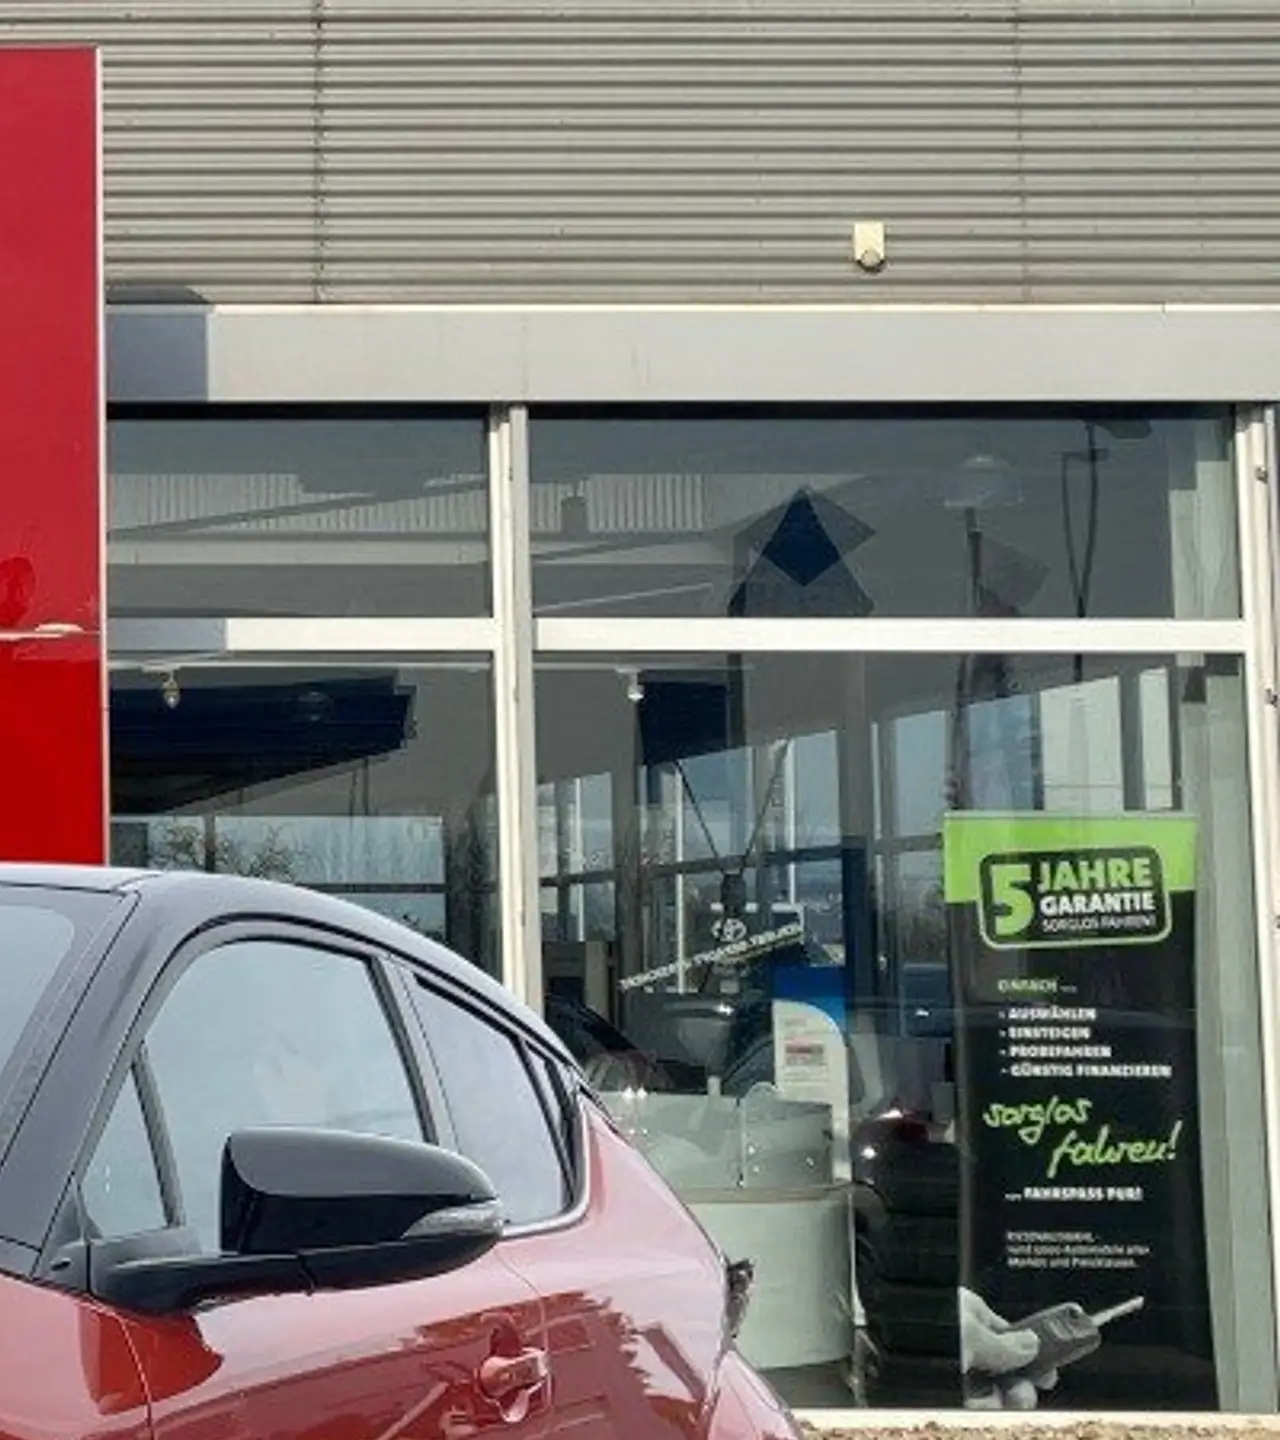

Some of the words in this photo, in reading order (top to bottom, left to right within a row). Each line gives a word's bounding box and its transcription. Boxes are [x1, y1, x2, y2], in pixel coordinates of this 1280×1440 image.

[991, 863, 1035, 936] 5
[1037, 857, 1154, 893] JAHRE
[1040, 892, 1157, 916] GARANTIE
[983, 1095, 1093, 1146] sorglos
